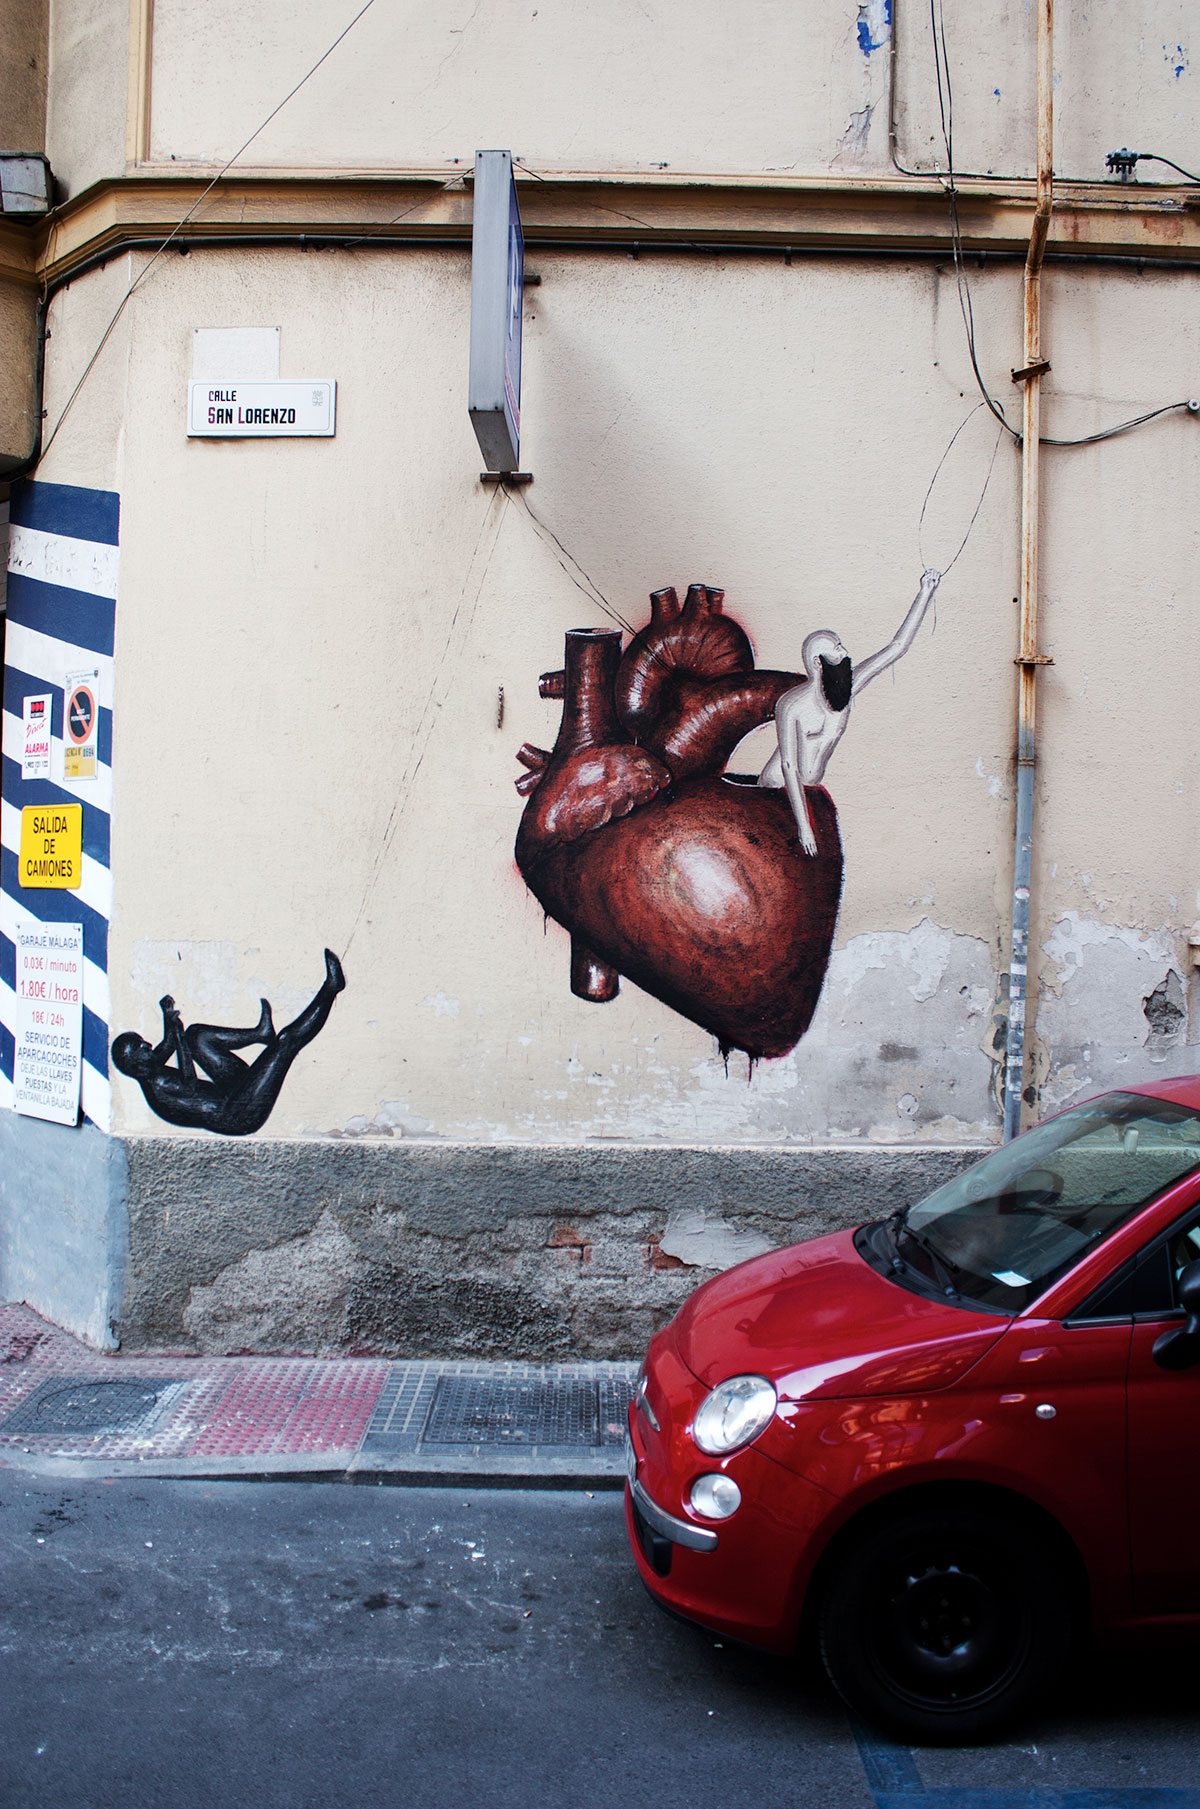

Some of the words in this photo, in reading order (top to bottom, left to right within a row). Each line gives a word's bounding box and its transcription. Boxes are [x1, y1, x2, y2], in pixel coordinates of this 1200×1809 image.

[208, 390, 237, 402] CALLE
[208, 406, 233, 424] SAN
[238, 406, 296, 424] LORENZO
[25, 742, 48, 754] ALARMA
[32, 816, 68, 834] SALIDA
[44, 838, 55, 855] DE
[26, 859, 72, 878] CAMIONES
[50, 959, 77, 973] minuto
[55, 983, 78, 1002] hora
[50, 1013, 64, 1026] 24h
[25, 1031, 58, 1047] SERVICIO
[60, 1036, 70, 1049] DE
[18, 1046, 77, 1068] APARCACOCHES
[20, 1062, 36, 1073] DEJE
[36, 1065, 48, 1076] LAS
[49, 1068, 72, 1082] LLAVES
[25, 1077, 52, 1092] PUESTAS
[58, 1084, 66, 1095] LA
[16, 1089, 50, 1105] VENTANILLA
[51, 1096, 74, 1110] BAJADA
